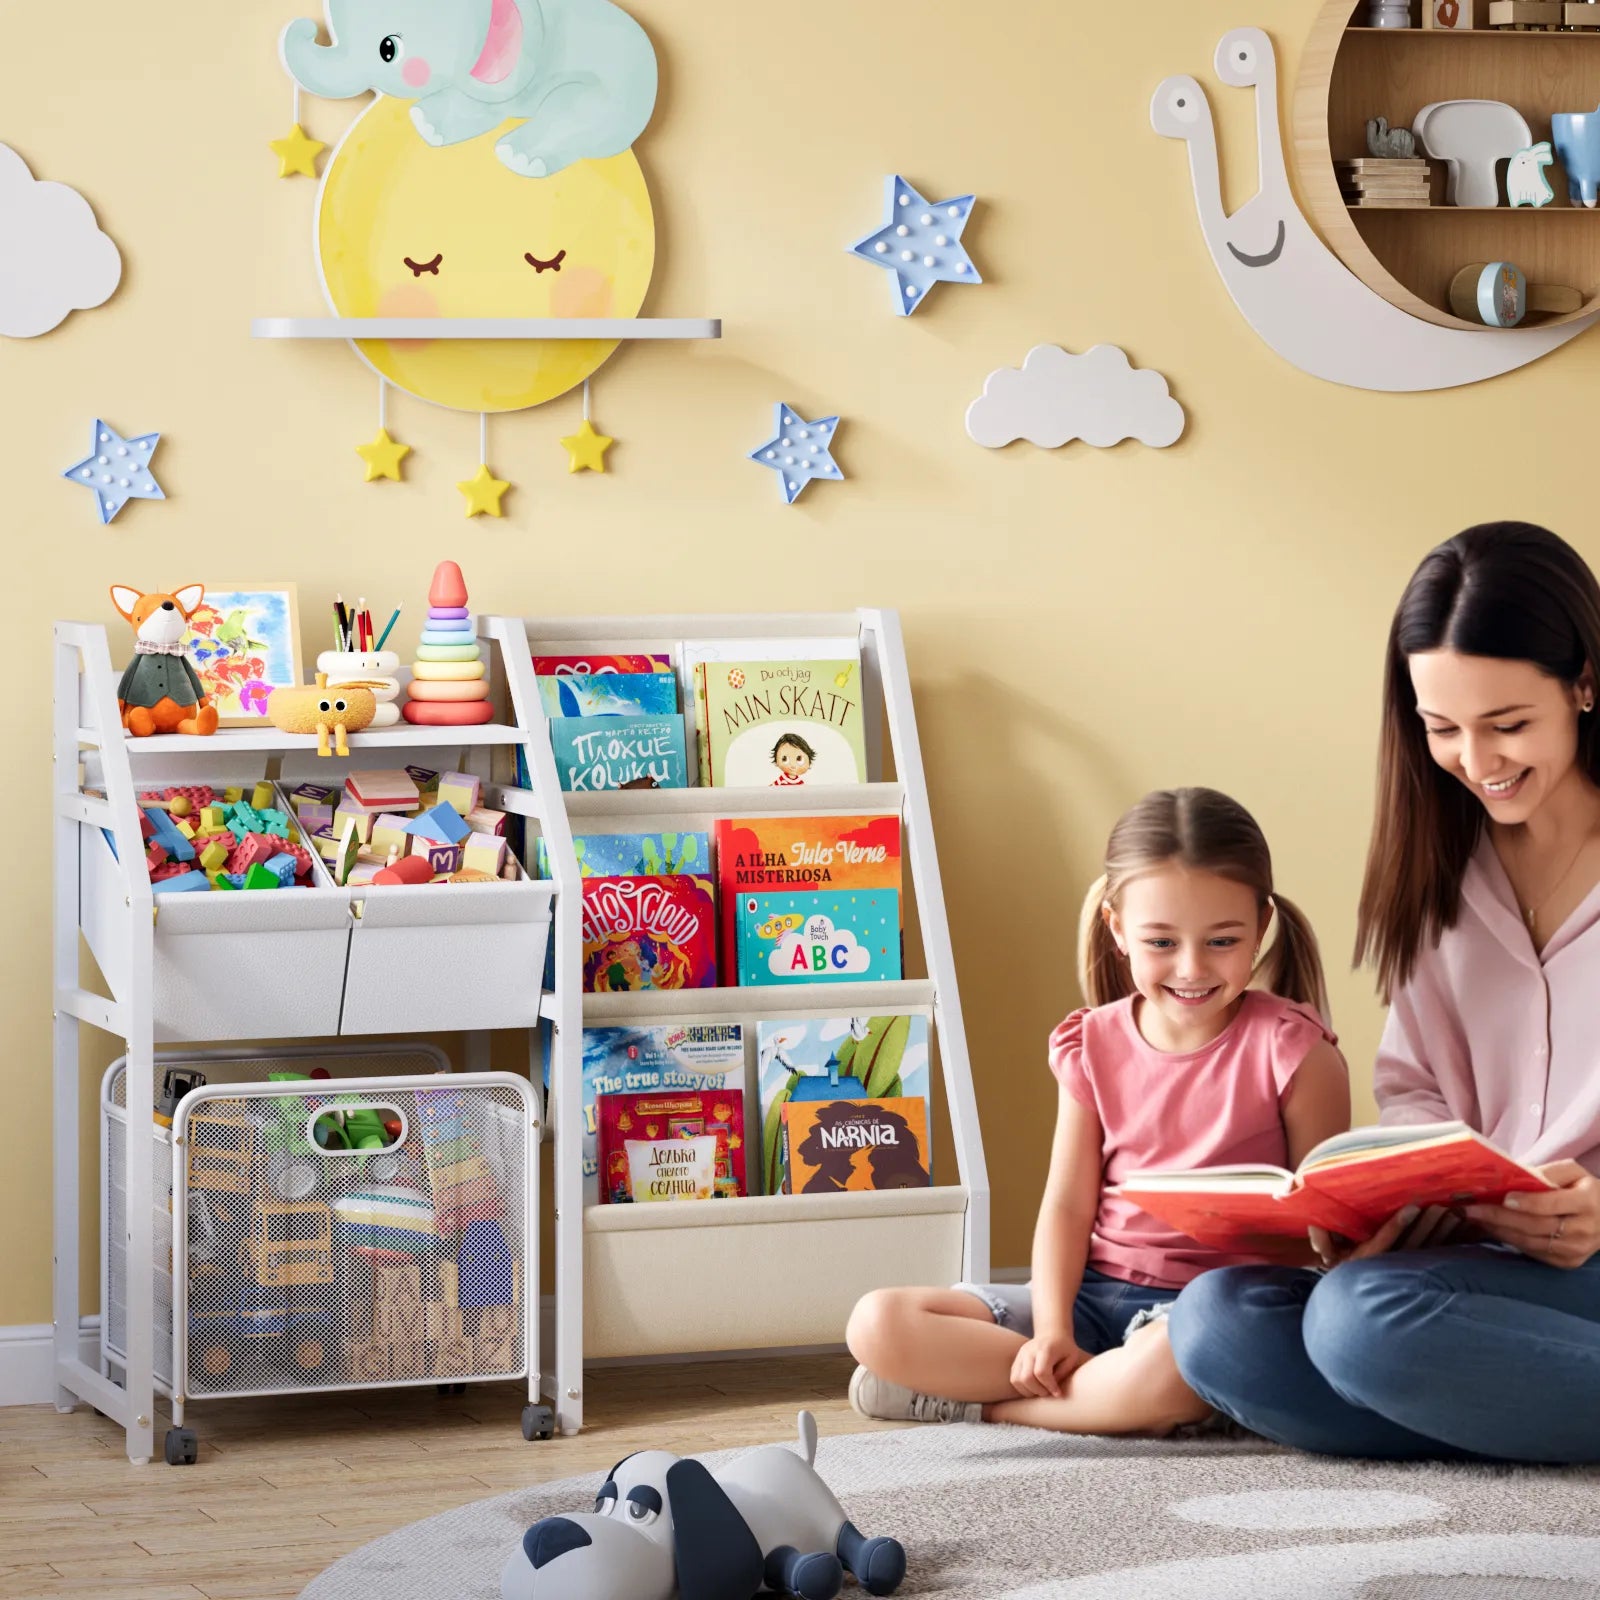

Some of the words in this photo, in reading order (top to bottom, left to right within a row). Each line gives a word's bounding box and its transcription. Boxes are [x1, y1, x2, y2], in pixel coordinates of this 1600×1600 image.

[761, 670, 774, 682] Du
[777, 667, 792, 678] och
[791, 667, 811, 683] jag
[723, 689, 772, 735] MIN
[779, 685, 856, 727] SKATT
[432, 850, 454, 873] M
[735, 854, 746, 867] A
[750, 853, 787, 867] ILHA
[790, 841, 834, 867] Jules
[836, 840, 887, 865] Verne
[736, 868, 832, 884] MISTERIOSA
[810, 925, 827, 934] Baby
[810, 933, 829, 941] Touch
[791, 944, 849, 971] ABC
[592, 1076, 622, 1094] The
[625, 1071, 660, 1089] true
[663, 1071, 705, 1091] story
[707, 1072, 726, 1089] of
